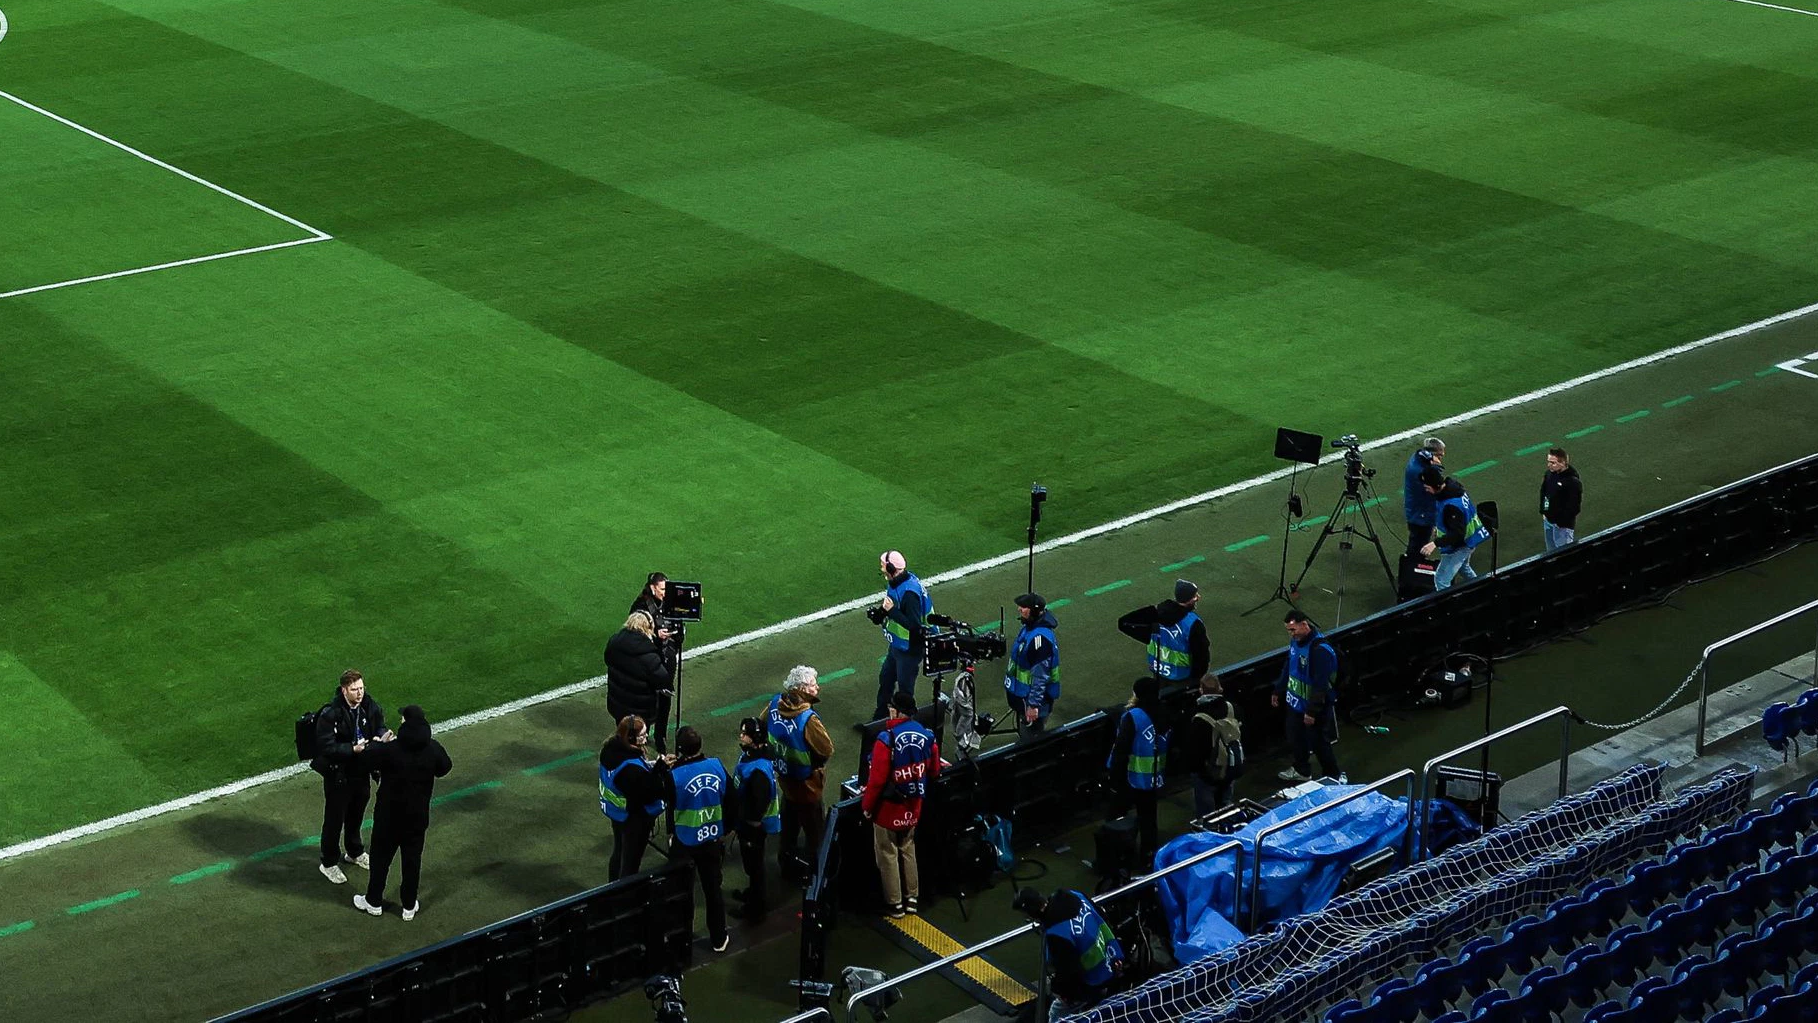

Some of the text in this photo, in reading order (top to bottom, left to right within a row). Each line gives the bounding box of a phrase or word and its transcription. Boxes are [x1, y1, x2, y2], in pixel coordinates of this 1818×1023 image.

[895, 735, 925, 752] UEFA
[686, 776, 720, 795] UEFA
[698, 808, 715, 822] TV
[697, 824, 719, 842] 830
